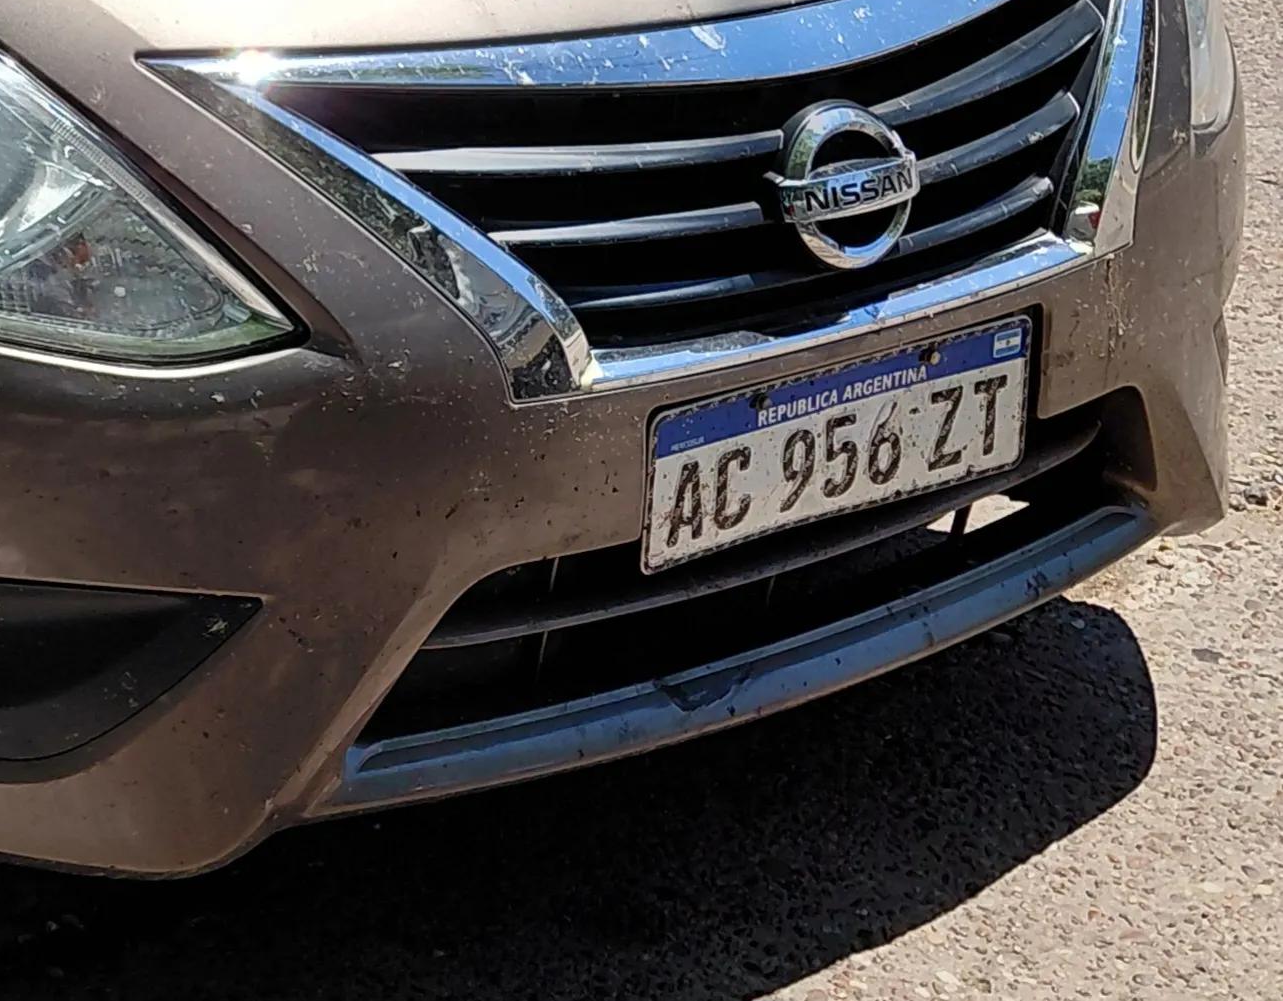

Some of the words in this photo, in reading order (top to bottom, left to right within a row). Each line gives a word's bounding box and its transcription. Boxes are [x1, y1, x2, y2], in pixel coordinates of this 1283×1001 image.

[804, 168, 914, 212] NISSAN
[757, 388, 839, 428] REPUBLICA
[842, 365, 928, 402] ARGENTINA
[666, 445, 751, 548] AC
[779, 401, 902, 513] 956
[927, 375, 1009, 473] ZT
